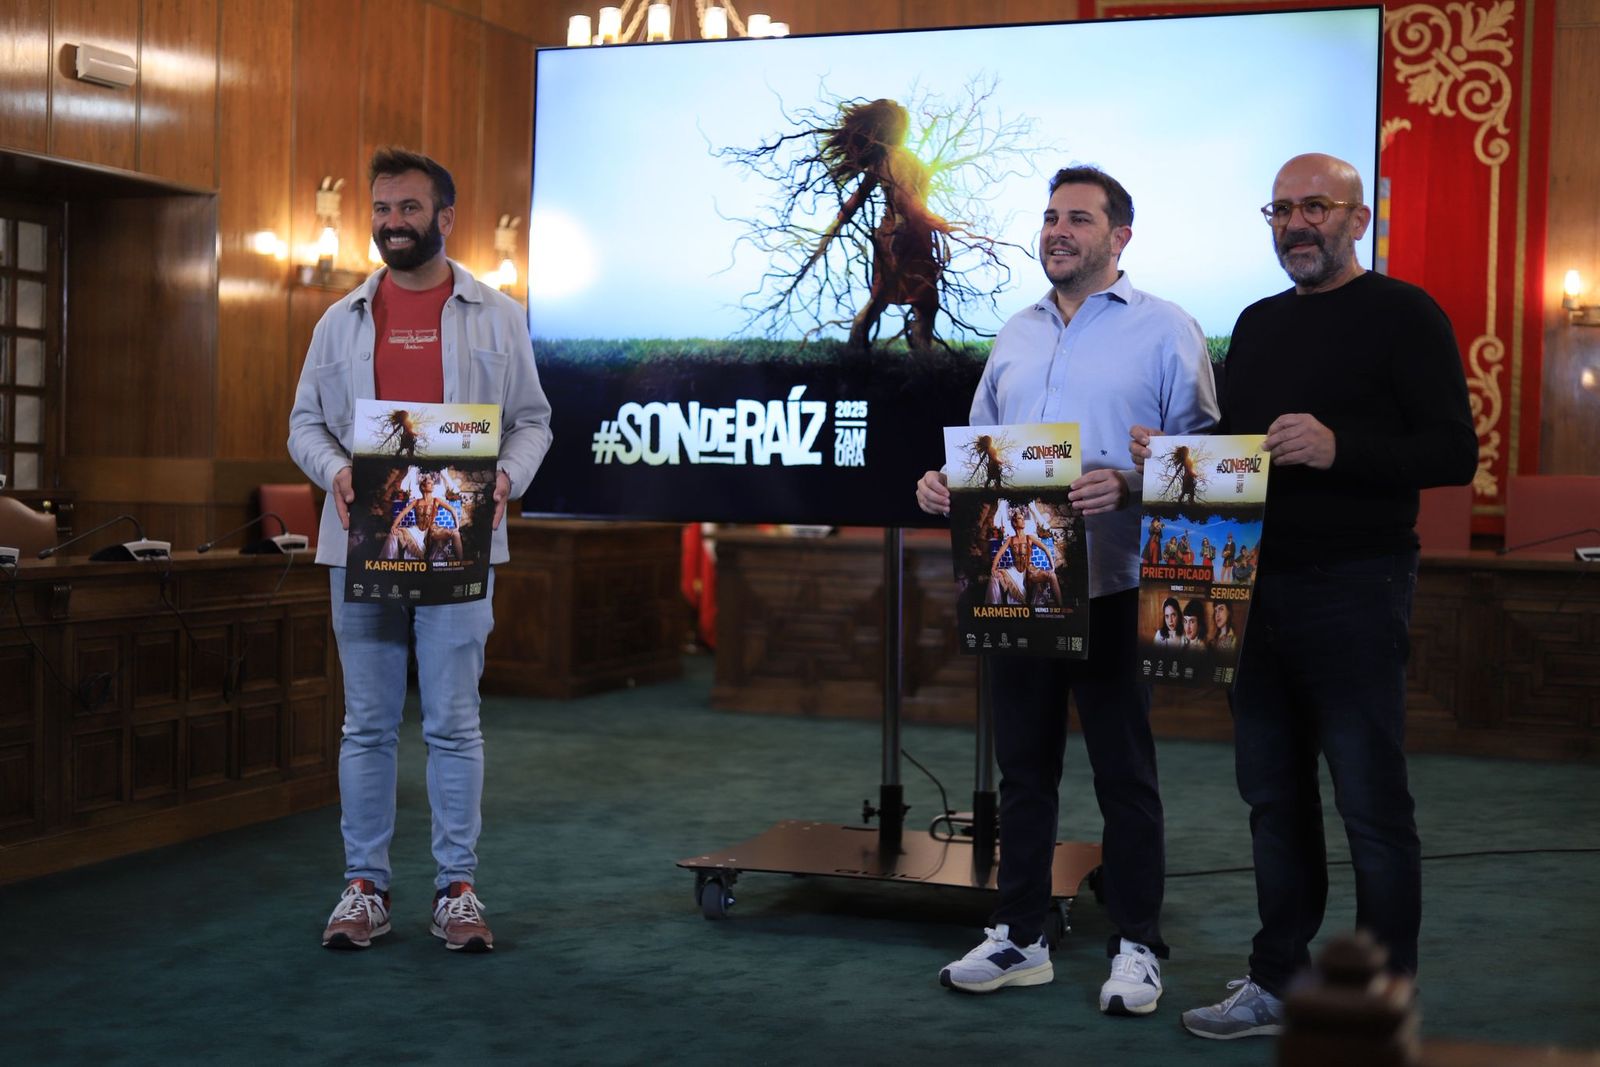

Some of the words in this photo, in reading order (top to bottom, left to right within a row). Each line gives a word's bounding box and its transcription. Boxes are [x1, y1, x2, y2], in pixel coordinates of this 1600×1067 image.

[834, 400, 868, 418] 2025
[834, 428, 867, 449] ZAM
[834, 447, 866, 467] ORA
[365, 560, 427, 572] KARMENTO
[1142, 566, 1176, 579] PRIETO
[1177, 568, 1212, 580] PICADO
[1210, 587, 1250, 600] SERIGOSA
[973, 607, 1030, 618] KARMENTO
